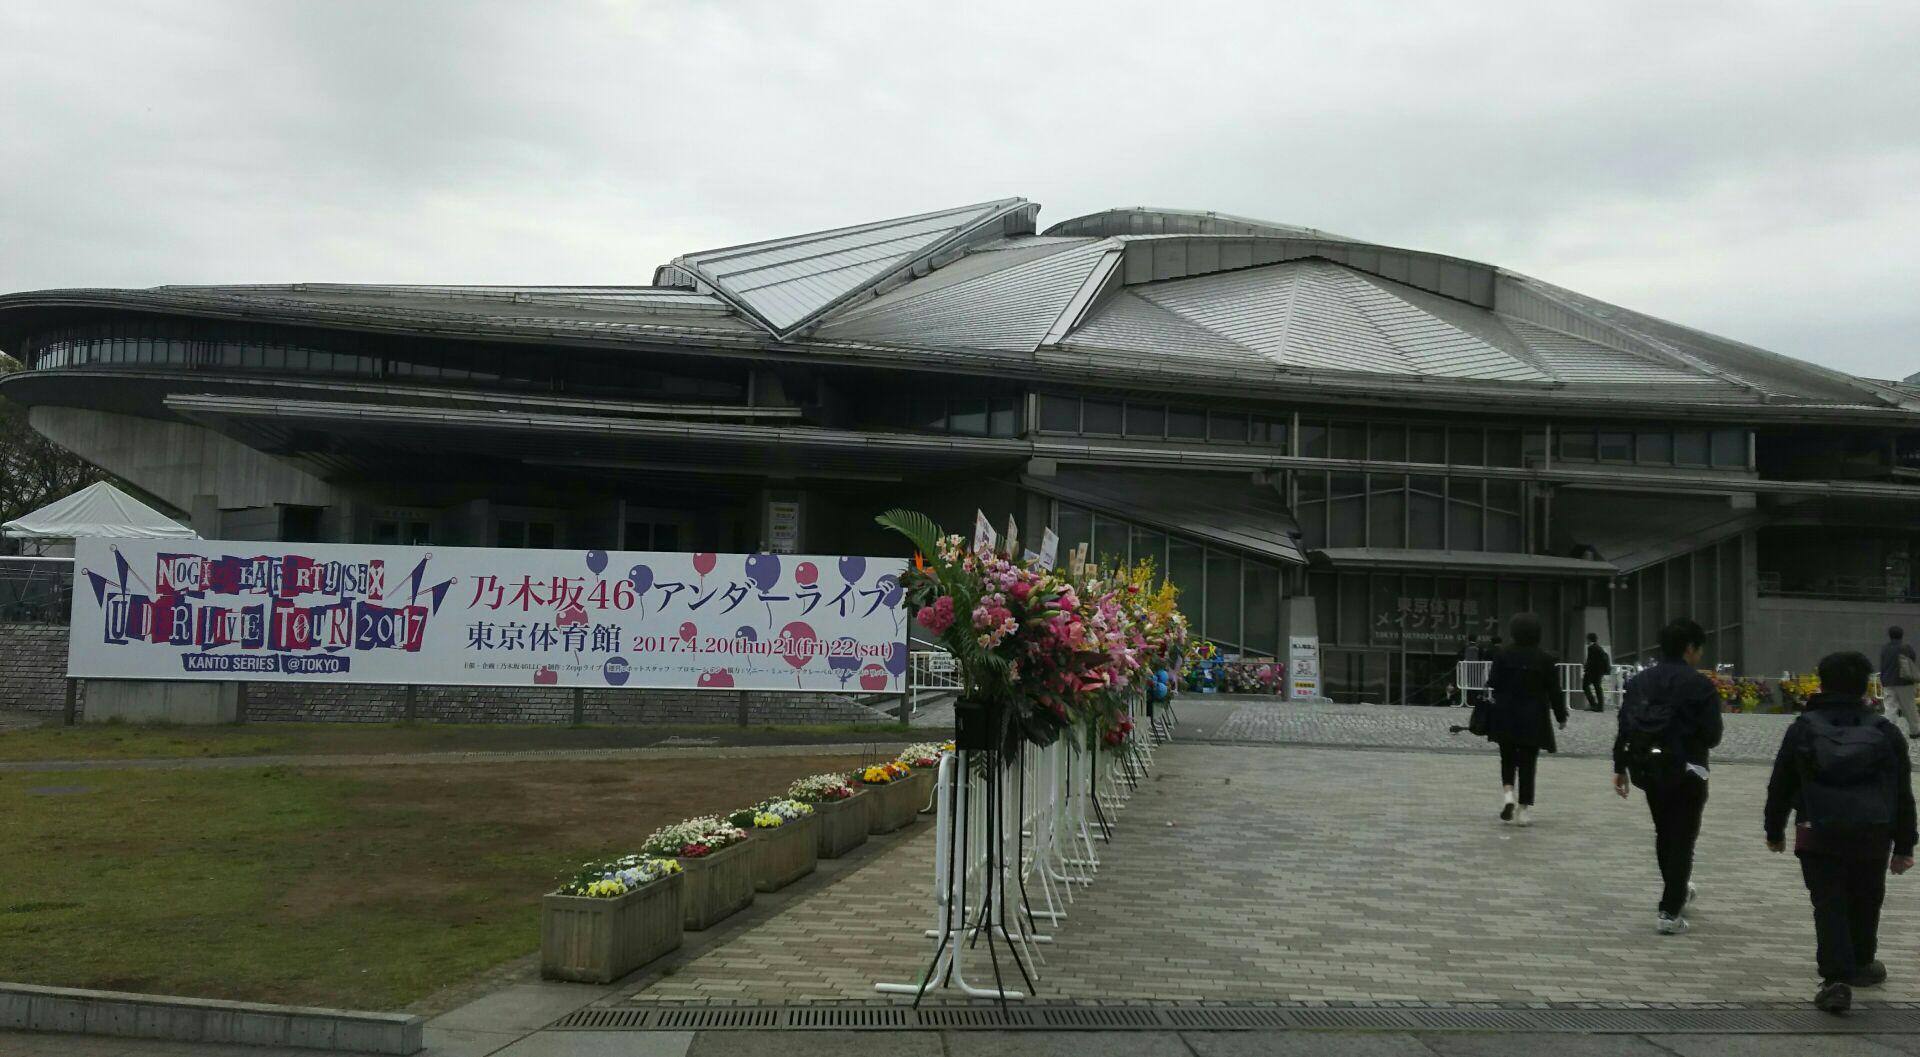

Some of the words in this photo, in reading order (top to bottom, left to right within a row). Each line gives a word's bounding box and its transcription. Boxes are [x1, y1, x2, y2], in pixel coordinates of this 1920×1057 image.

[467, 574, 635, 612] 乃木坂46
[653, 578, 895, 618] アンダーライブ
[1396, 597, 1479, 615] 東京体育館
[359, 608, 425, 649] 2017
[1375, 611, 1499, 630] メインアリーナ
[464, 621, 622, 653] 東京体育館
[188, 656, 229, 669] KANTO
[232, 657, 275, 671] SERIES
[288, 658, 339, 672] @TOKYO
